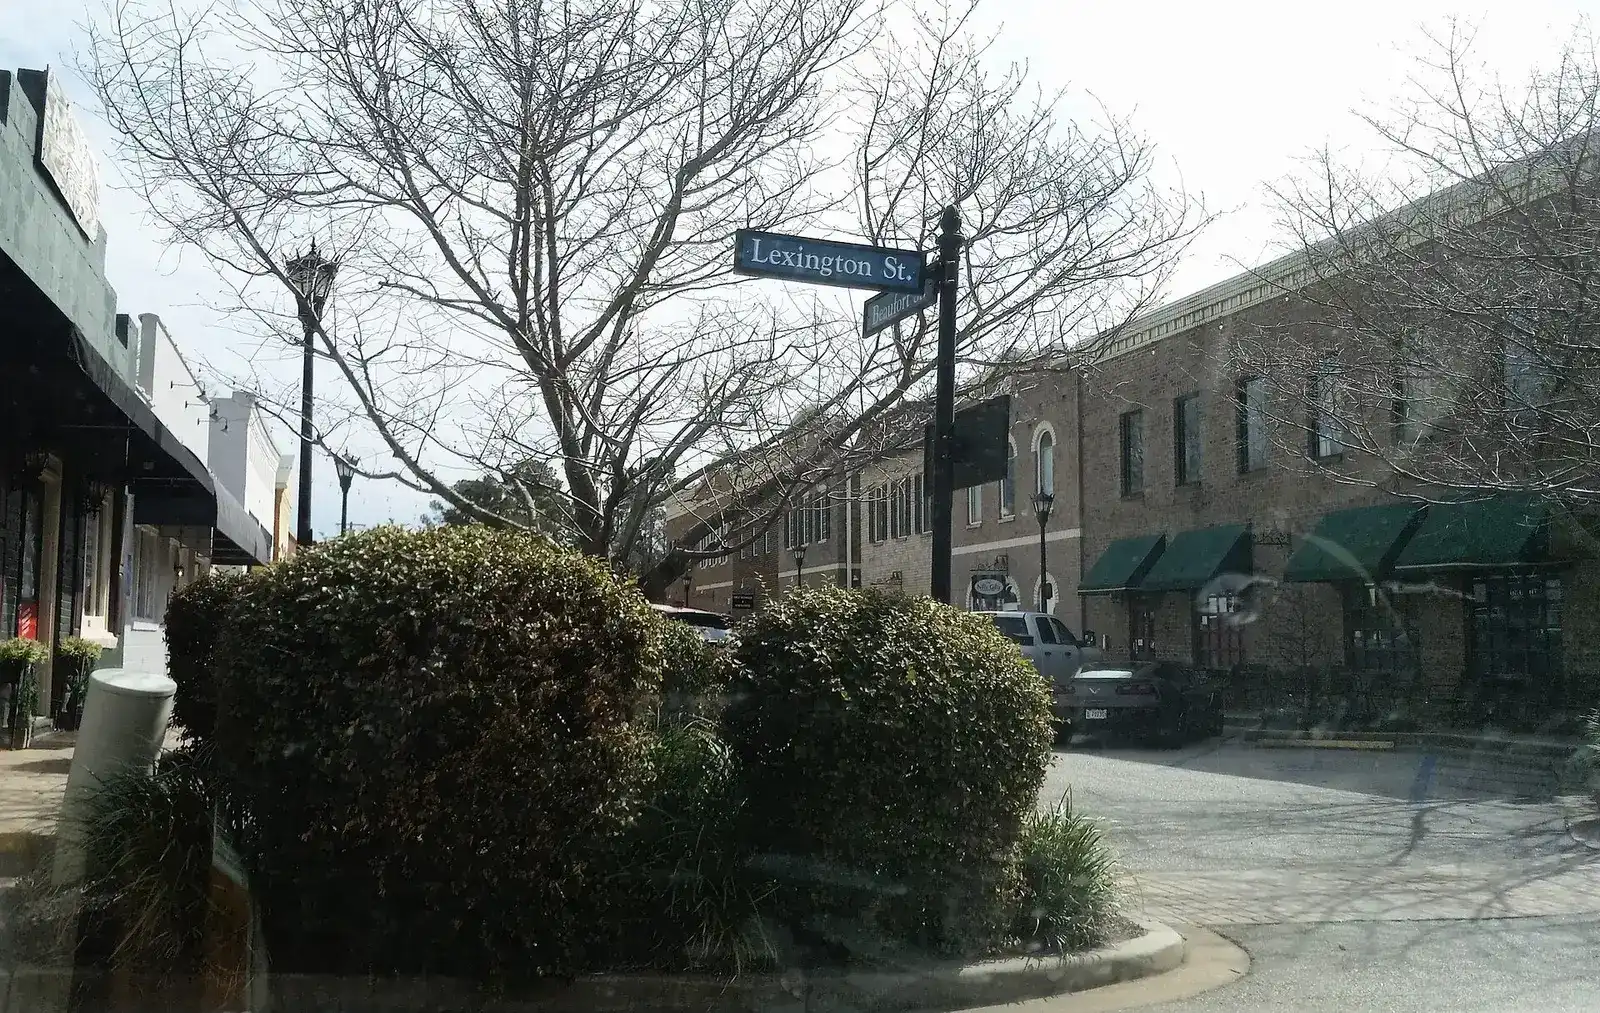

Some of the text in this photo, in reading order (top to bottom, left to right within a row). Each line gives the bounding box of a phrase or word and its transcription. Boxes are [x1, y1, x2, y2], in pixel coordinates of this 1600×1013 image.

[751, 238, 912, 281] Lexington St.
[872, 293, 909, 326] Beaufort
